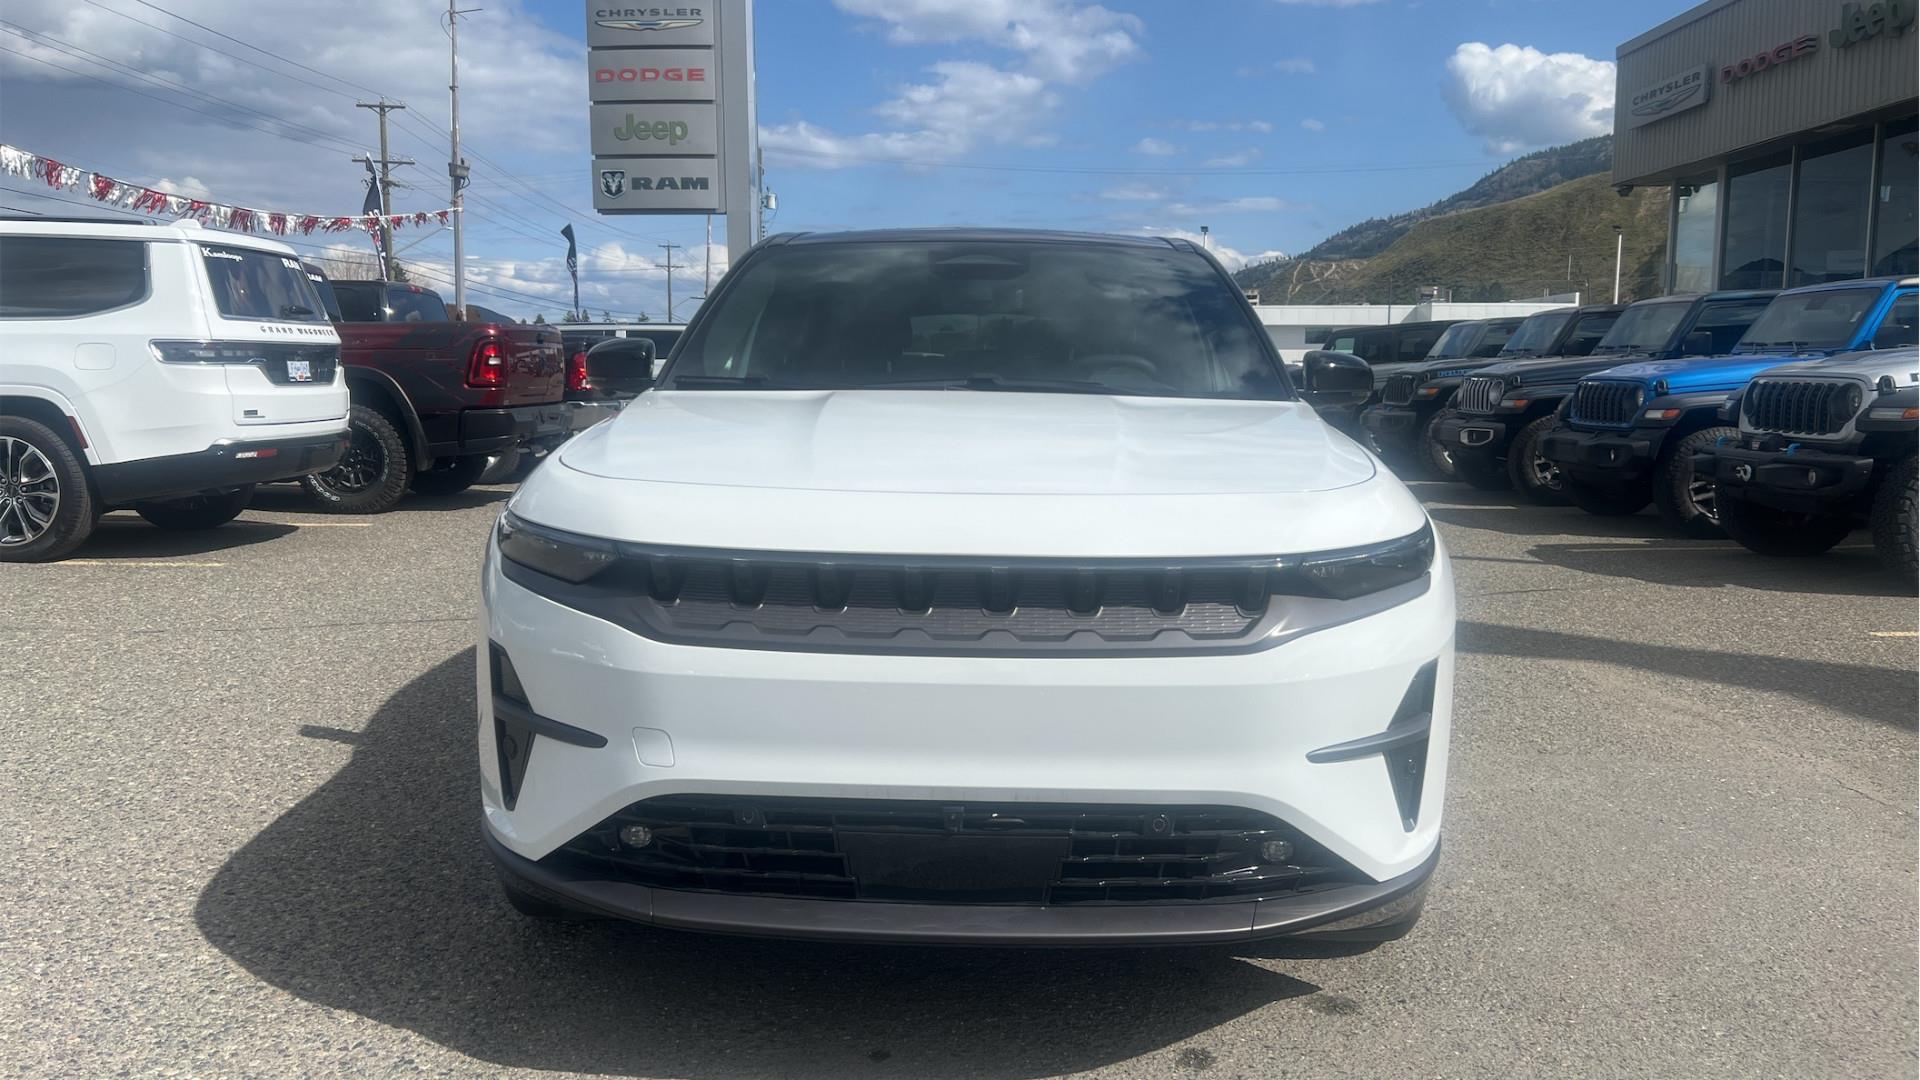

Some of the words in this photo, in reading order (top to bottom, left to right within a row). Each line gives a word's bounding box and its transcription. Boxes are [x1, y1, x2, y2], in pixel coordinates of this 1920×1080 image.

[595, 8, 702, 18] CHRYSLER
[1720, 34, 1818, 84] DODGE
[595, 68, 705, 83] DODGE
[1632, 72, 1701, 106] CHRYSLER
[613, 112, 689, 146] Jeep
[631, 177, 709, 190] RAM
[260, 325, 294, 334] GRAND
